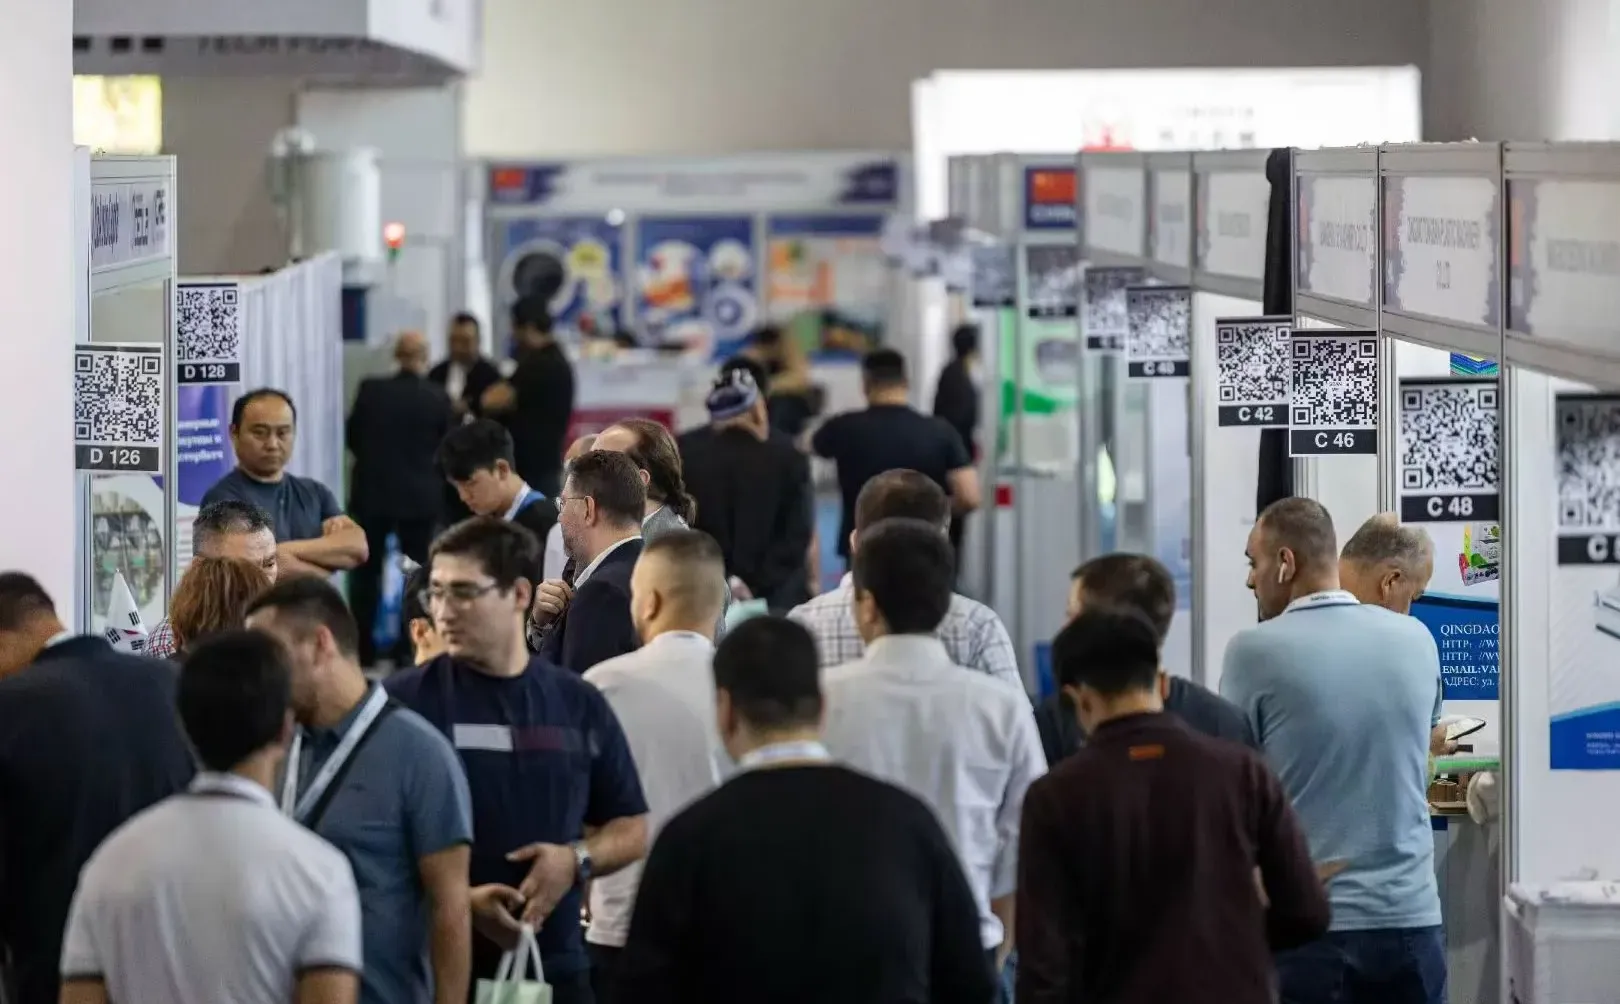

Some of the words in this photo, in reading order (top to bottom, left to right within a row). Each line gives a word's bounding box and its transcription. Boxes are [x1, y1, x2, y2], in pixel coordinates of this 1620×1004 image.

[184, 365, 196, 379] D
[200, 364, 226, 379] 128
[1238, 406, 1251, 421] C
[1254, 406, 1274, 421] 42
[1314, 432, 1328, 448] C
[1333, 432, 1355, 448] 46
[90, 449, 104, 464] D
[110, 449, 141, 465] 126
[1427, 496, 1443, 517] C
[1448, 496, 1474, 516] 48
[1587, 534, 1610, 562] C
[1440, 624, 1500, 637] QINGDAO
[1442, 639, 1472, 649] HTTP:
[1479, 639, 1500, 649] //W
[1442, 651, 1472, 661] HTTP:
[1443, 676, 1480, 687] АДРЕС:
